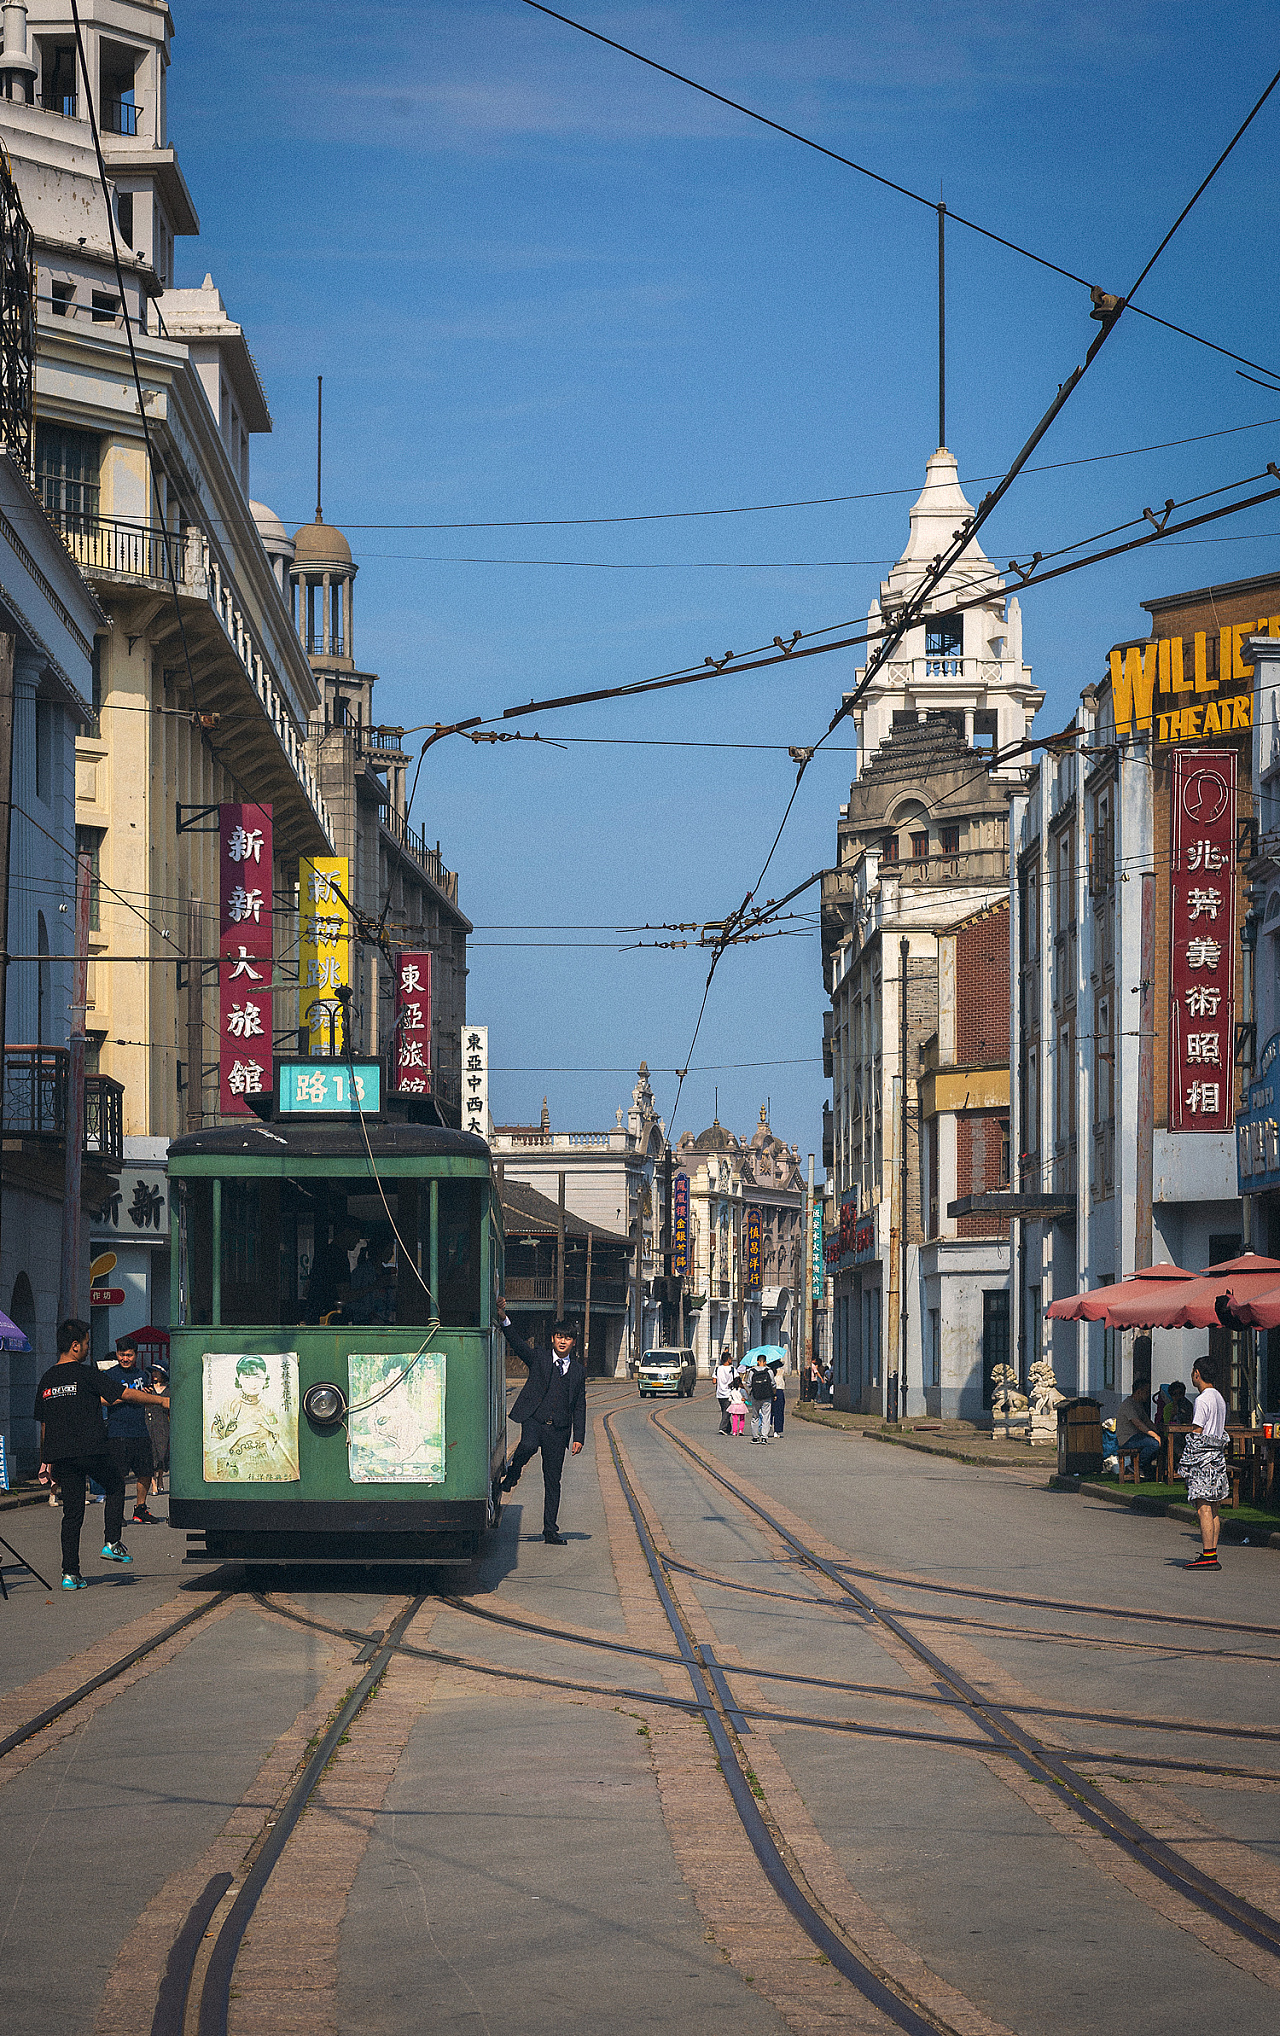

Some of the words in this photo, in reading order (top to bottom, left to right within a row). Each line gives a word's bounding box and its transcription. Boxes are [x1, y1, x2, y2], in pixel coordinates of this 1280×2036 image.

[1110, 614, 1280, 734] WILLIE'
[1156, 692, 1254, 743] THEATR
[227, 825, 266, 1095] 新新大旅館
[1184, 840, 1224, 1113] 兆芳美術照相
